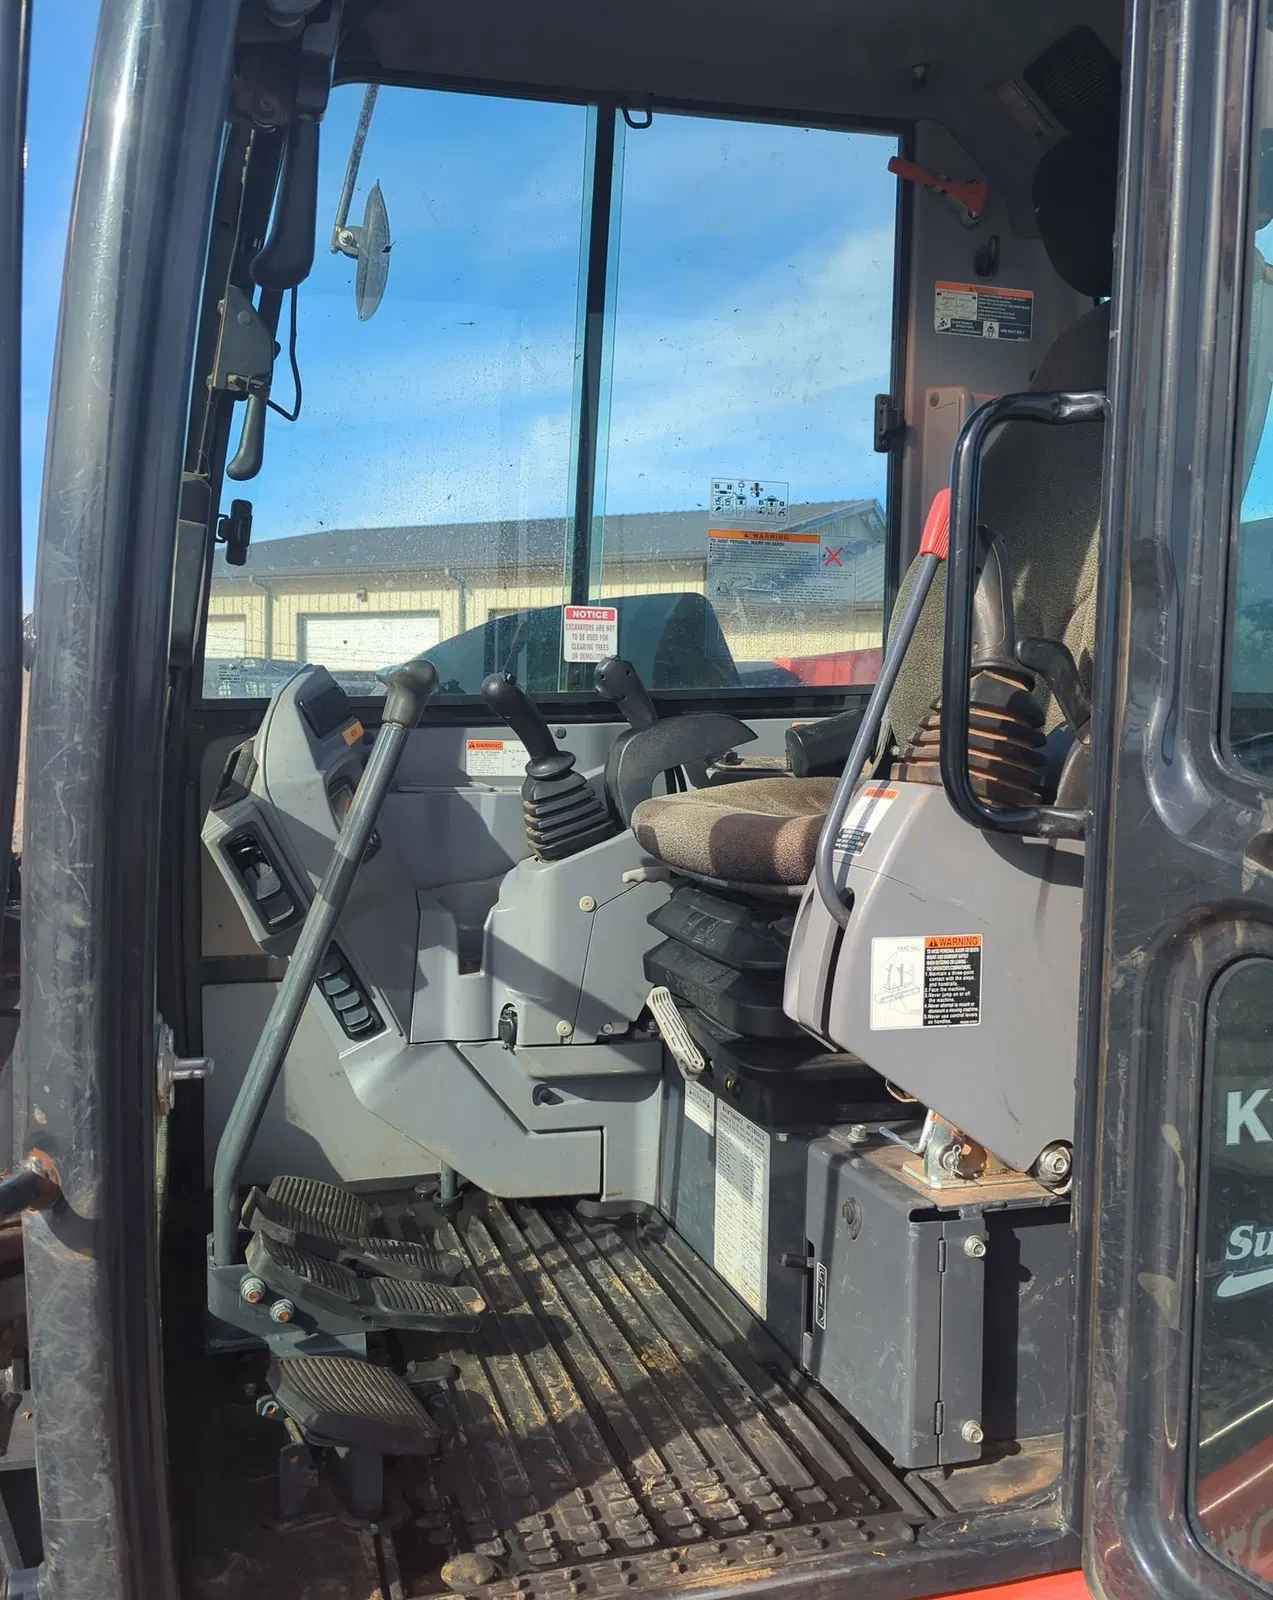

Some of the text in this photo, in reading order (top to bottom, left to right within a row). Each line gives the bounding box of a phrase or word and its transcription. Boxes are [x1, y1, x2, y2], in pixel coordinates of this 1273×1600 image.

[573, 610, 608, 619] NOTICE
[939, 937, 978, 946] WARNING
[1225, 1225, 1273, 1260] Su
